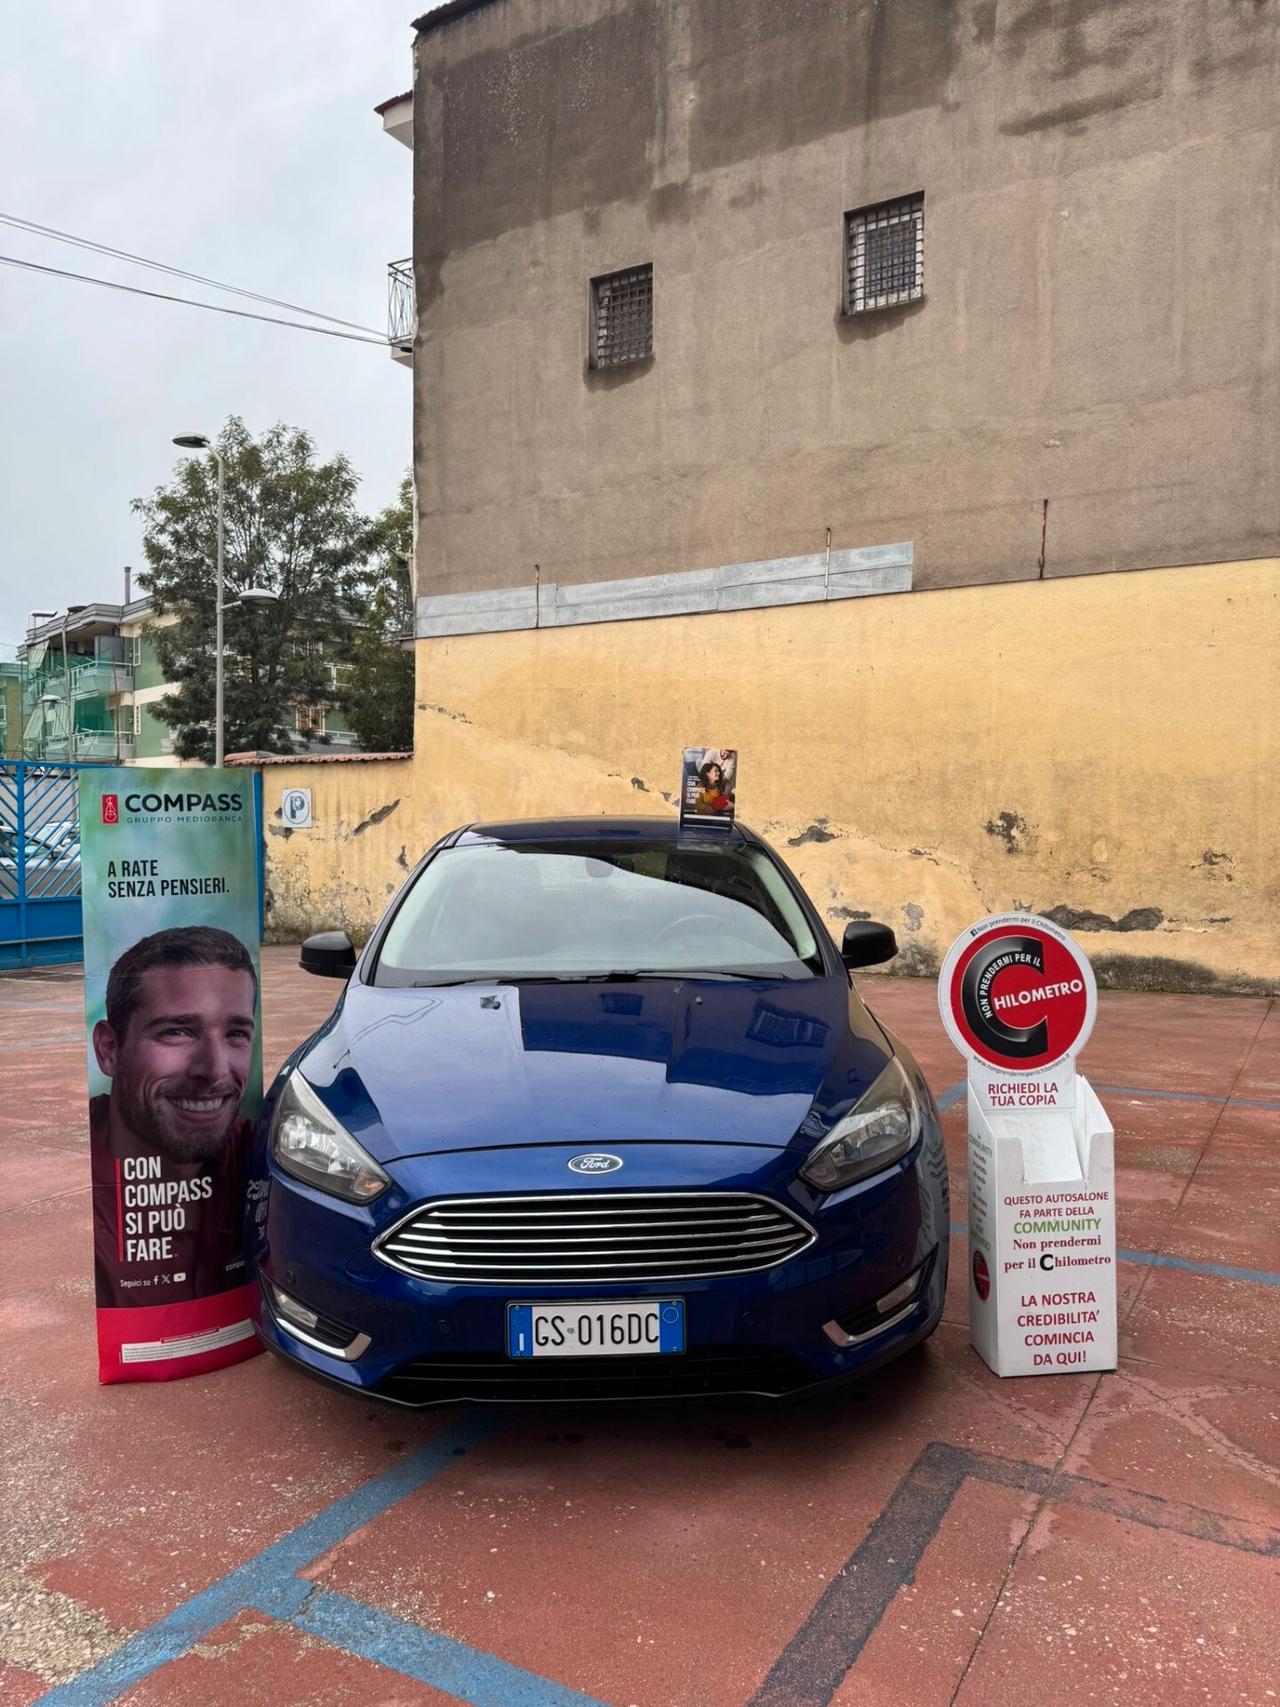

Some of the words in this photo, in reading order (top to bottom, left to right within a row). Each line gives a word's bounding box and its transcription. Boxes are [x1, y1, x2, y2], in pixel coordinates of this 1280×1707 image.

[125, 794, 243, 813] COMPASS
[126, 816, 172, 824] GRUPPO
[177, 815, 242, 823] MEDIOBANCA
[108, 861, 117, 877] A
[122, 860, 159, 877] RATE
[108, 880, 155, 898] SENZA
[161, 877, 230, 896] PENSIERI.
[1015, 953, 1032, 963] PER
[1033, 956, 1041, 967] IL
[980, 954, 1013, 996] PRENDERMI
[980, 999, 993, 1019] NON
[988, 1083, 1040, 1094] RICHIEDI
[1044, 1082, 1058, 1093] LA
[990, 1095, 1015, 1106] TUA
[1019, 1094, 1056, 1106] COPIA
[124, 1156, 161, 1180] CON
[125, 1176, 213, 1208] COMPASS
[1004, 1195, 1043, 1206] QUESTO
[1045, 1192, 1109, 1203] AUTOSALONE
[125, 1212, 142, 1235] SI
[148, 1203, 185, 1233] PUÒ
[1020, 1209, 1031, 1218] FA
[1034, 1208, 1063, 1218] PARTE
[1066, 1206, 1094, 1216] DELLA
[1014, 1218, 1101, 1234] COMMUNITY
[1013, 1239, 1036, 1250] Non
[1040, 1235, 1101, 1251] prendermi
[1004, 1261, 1024, 1273] per
[1028, 1258, 1036, 1269] il
[120, 1280, 142, 1288] Seguici
[1021, 1295, 1037, 1307] LA
[1042, 1291, 1096, 1306] NOSTRA
[1017, 1309, 1100, 1327] CREDIBILITA'
[535, 1315, 565, 1346] GS
[578, 1313, 659, 1345] 016DC
[1024, 1331, 1095, 1346] COMINCIA
[1033, 1353, 1052, 1365] DA
[1056, 1350, 1086, 1365] QUI!
